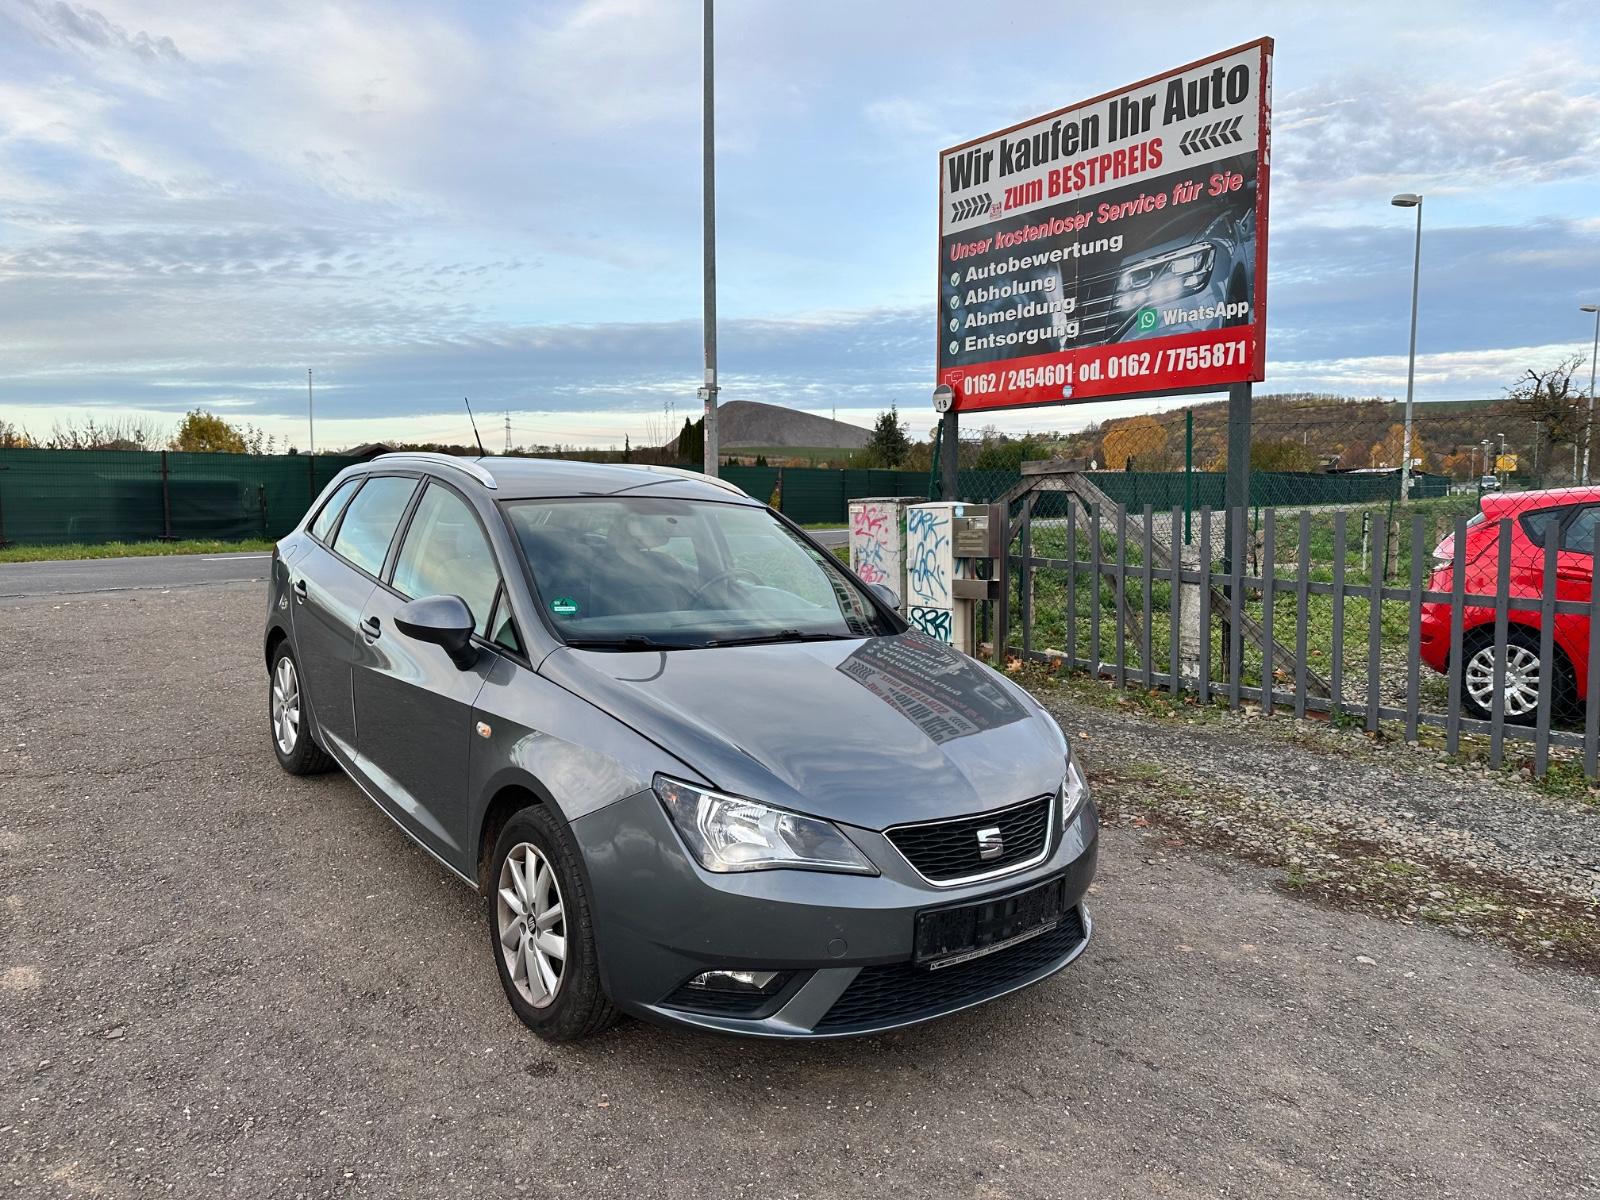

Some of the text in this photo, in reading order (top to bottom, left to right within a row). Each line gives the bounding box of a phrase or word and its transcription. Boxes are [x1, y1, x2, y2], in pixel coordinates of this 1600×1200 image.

[949, 64, 1249, 193] Wir kaufen Ihr Auto
[1004, 137, 1163, 211] zum BESTPREIS
[950, 237, 992, 261] Unser
[995, 211, 1093, 250] kostenloser
[1097, 192, 1167, 224] Service
[1172, 180, 1204, 206] für
[1208, 171, 1244, 196] Sie
[965, 234, 1124, 283] Autobewertung
[964, 296, 1076, 329] Abmeldung
[965, 275, 1057, 306] Abholung
[1163, 300, 1249, 326] WhatsApp
[965, 320, 1080, 352] Entsorgung
[964, 340, 1246, 396] 0162 / 2454601 od. 0162 / 7755871
